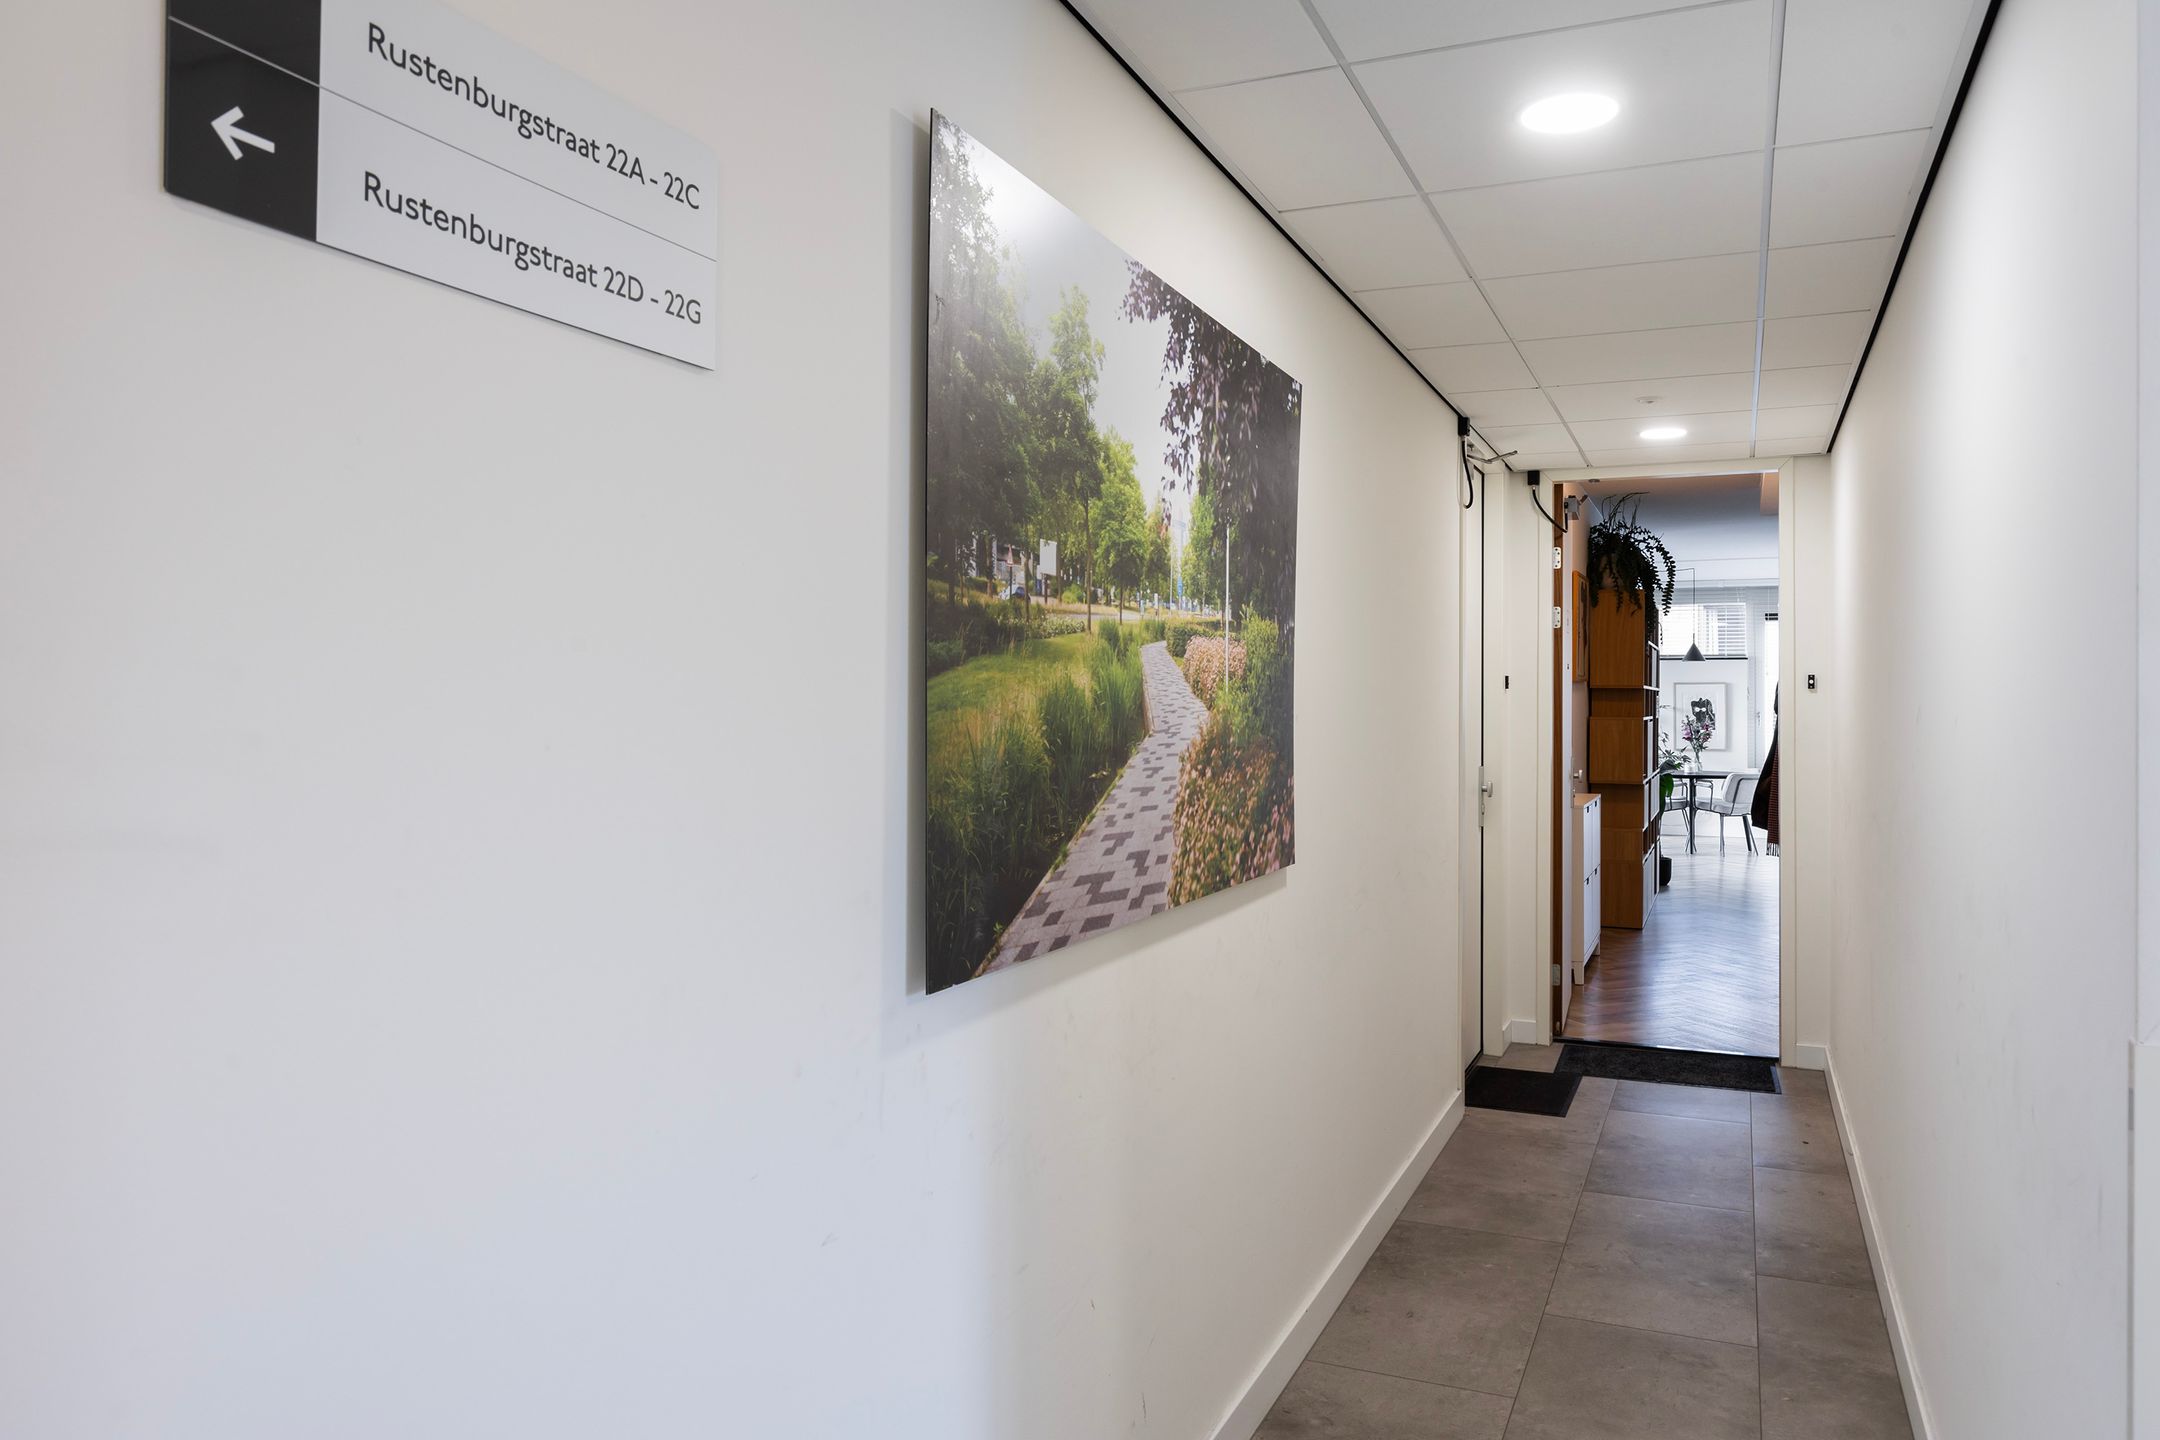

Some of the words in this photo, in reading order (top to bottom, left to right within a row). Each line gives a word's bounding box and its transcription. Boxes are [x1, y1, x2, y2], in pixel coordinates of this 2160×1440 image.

[368, 21, 601, 164] Rustenburgstraat
[603, 142, 646, 186] 22A
[663, 171, 701, 210] 22C
[364, 170, 598, 289] Rustenburgstraat
[603, 265, 644, 303] 22D
[664, 289, 702, 325] 22G
